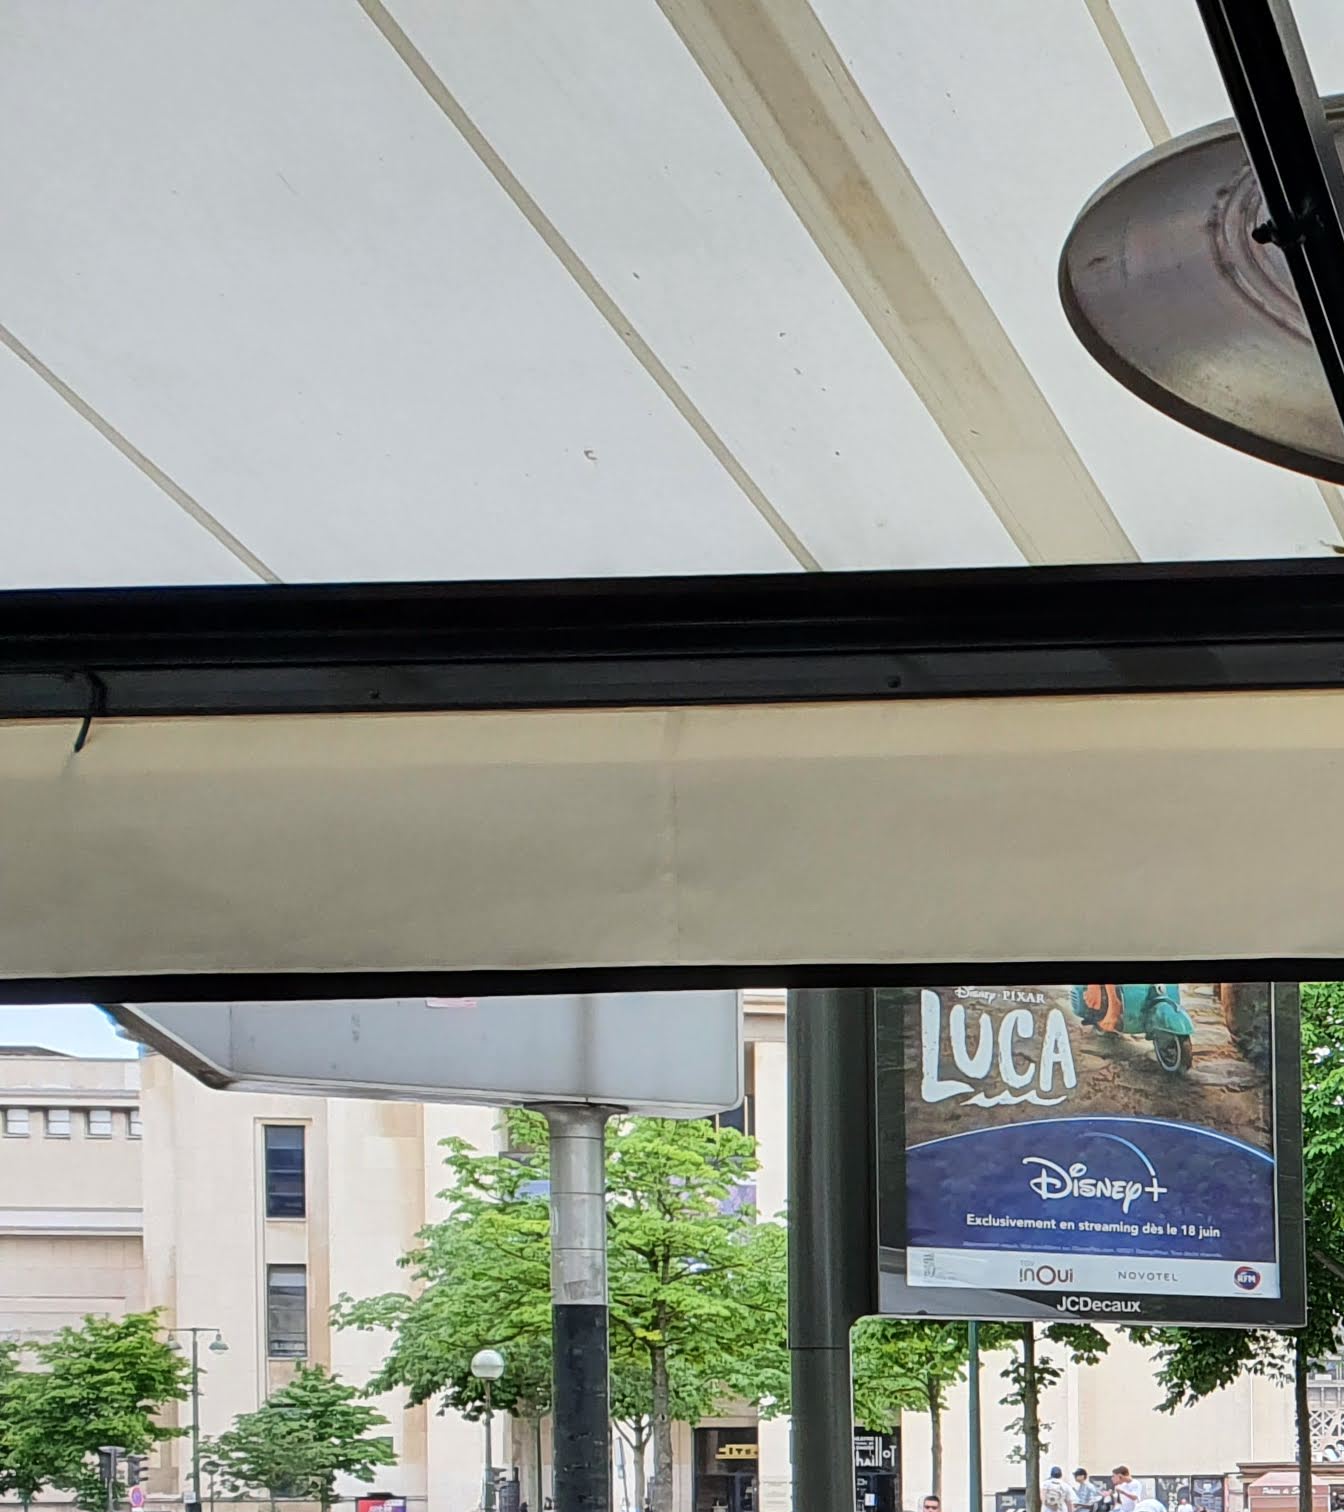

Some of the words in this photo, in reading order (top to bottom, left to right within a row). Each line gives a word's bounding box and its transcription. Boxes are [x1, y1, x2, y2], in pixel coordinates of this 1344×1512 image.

[1002, 990, 1046, 1004] PIXAR
[921, 989, 1077, 1103] LUCA
[966, 1214, 1057, 1230] Exclusivement
[1059, 1220, 1075, 1231] en
[1078, 1220, 1139, 1236] streaming
[1142, 1222, 1164, 1235] dès
[1166, 1223, 1178, 1236] le
[1180, 1224, 1196, 1237] 18
[1198, 1225, 1221, 1240] juin
[1117, 1271, 1179, 1282] NOVOTEL
[1056, 1296, 1142, 1313] JCDecaux
